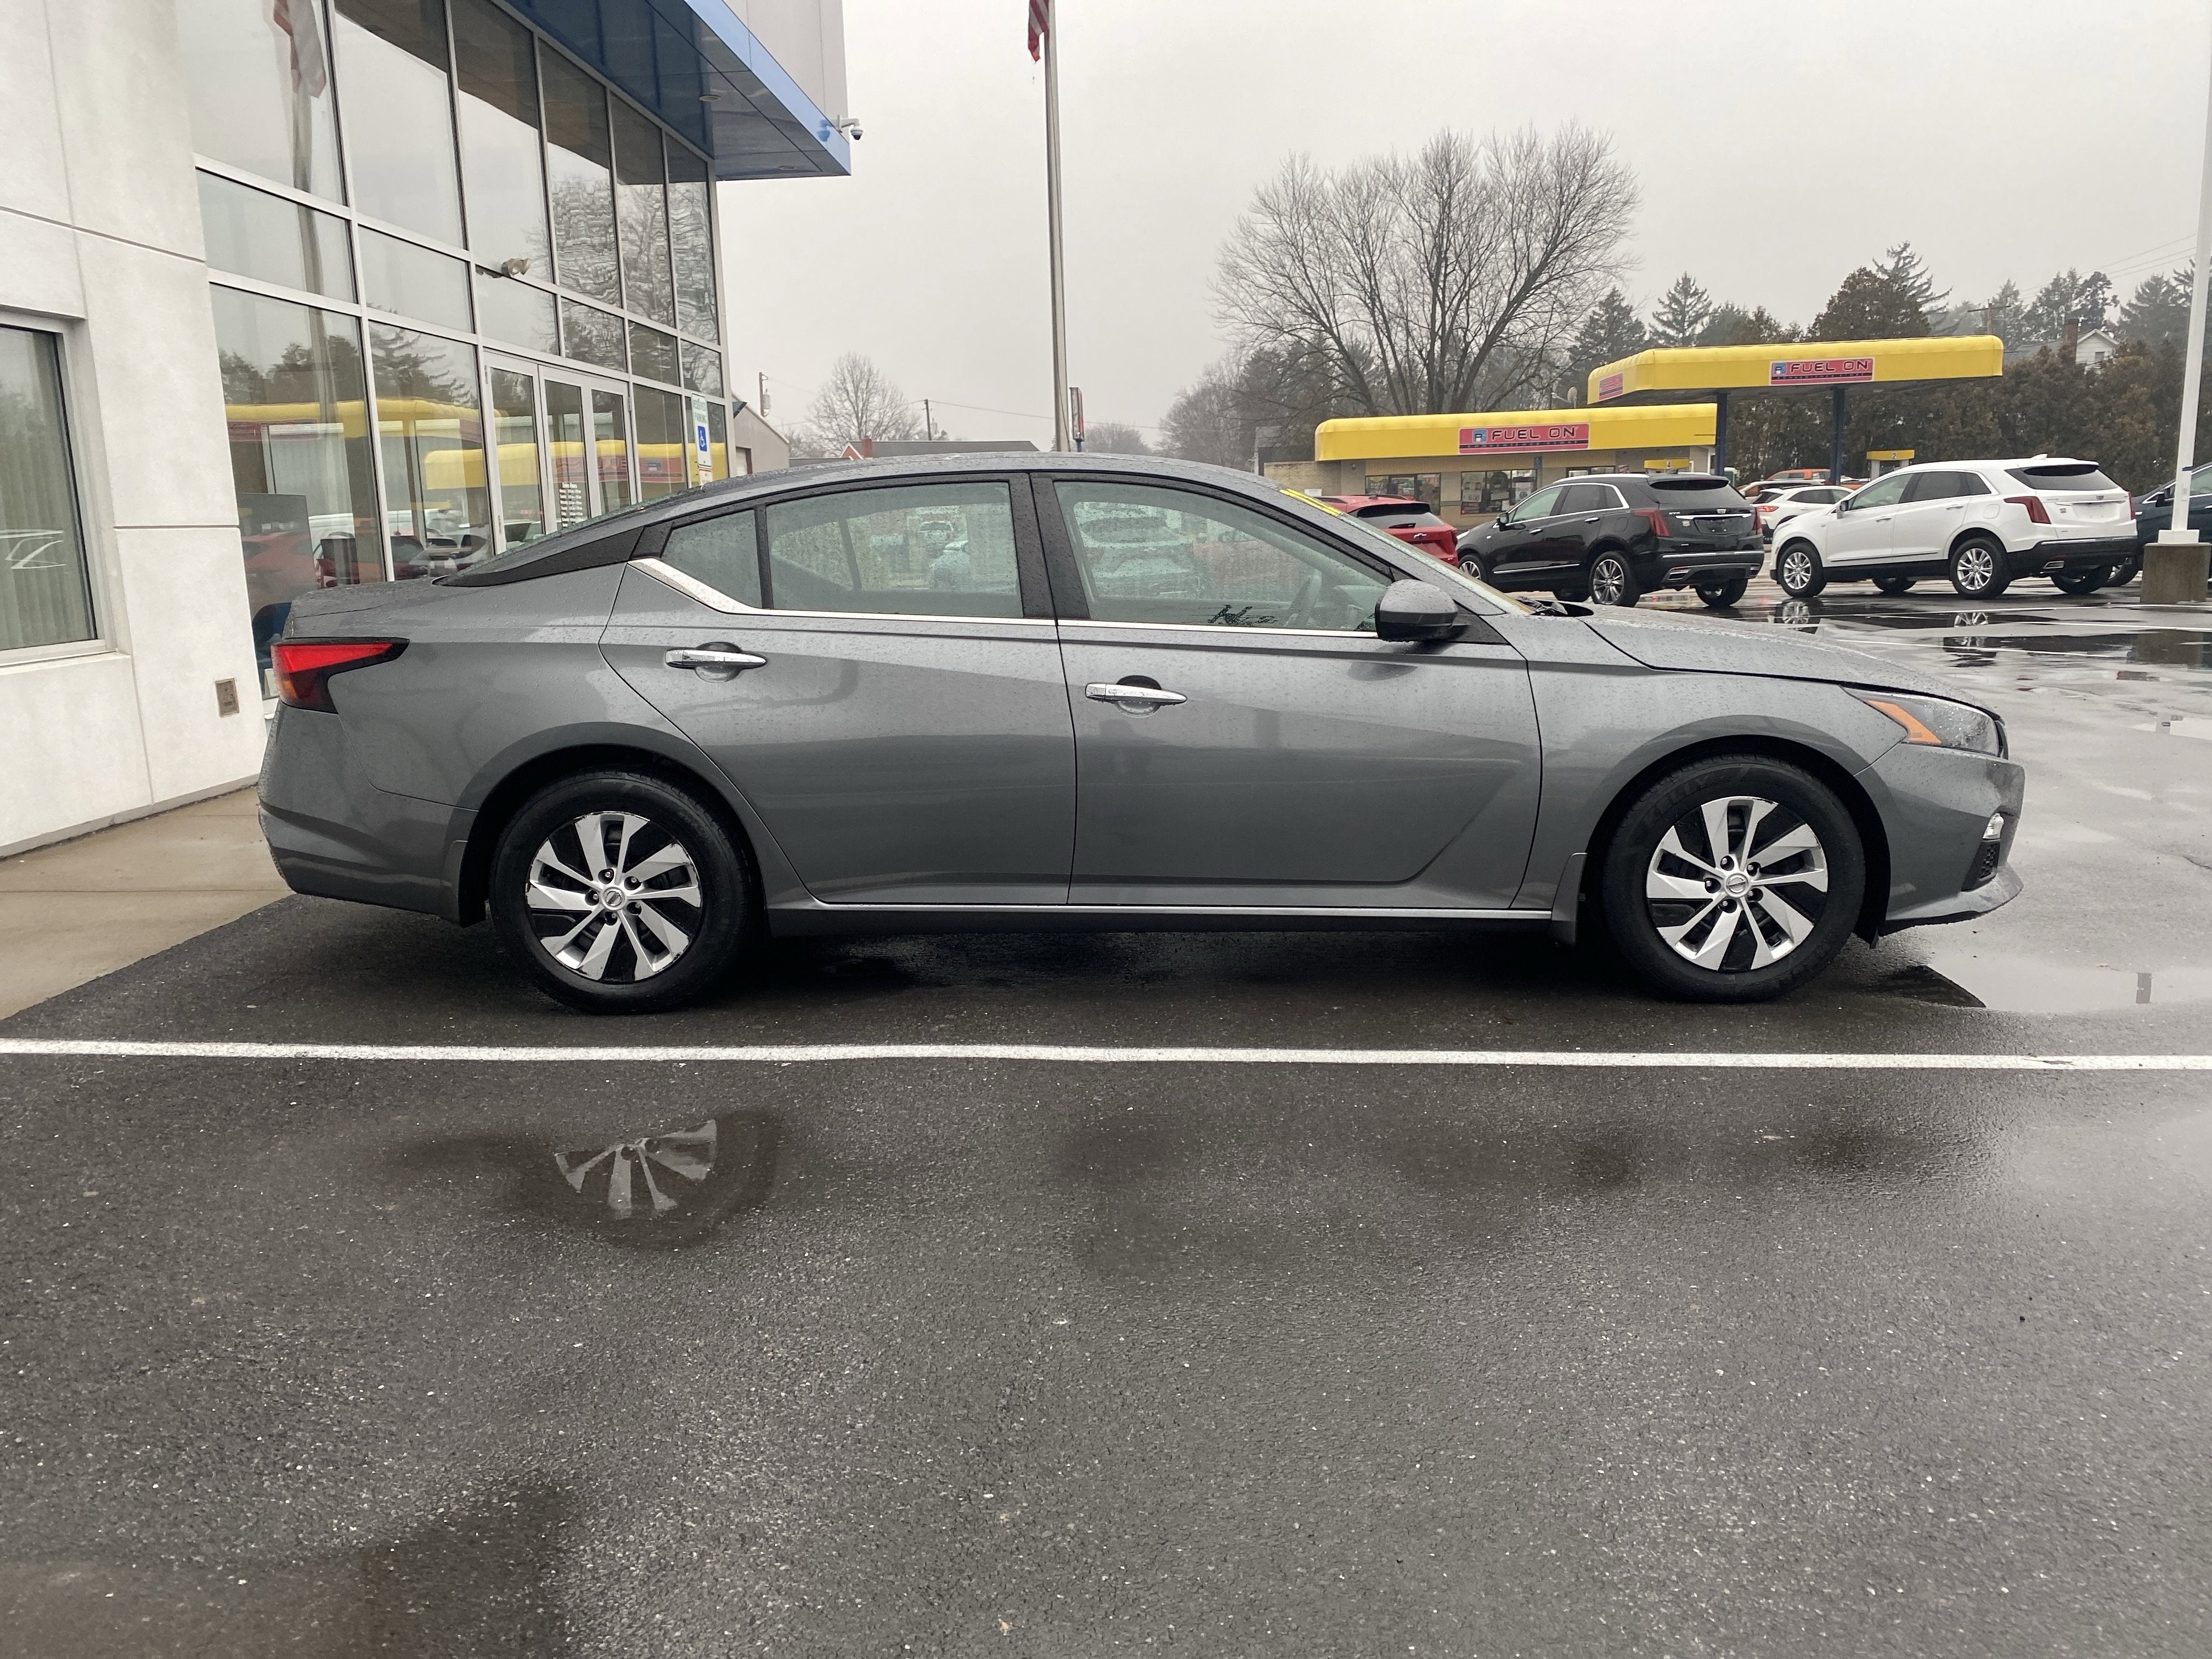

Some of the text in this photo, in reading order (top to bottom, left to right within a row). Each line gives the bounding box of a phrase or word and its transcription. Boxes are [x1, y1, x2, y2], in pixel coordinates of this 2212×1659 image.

[1791, 360, 1867, 373] FUEL ON
[1492, 427, 1575, 440] FUEL ON
